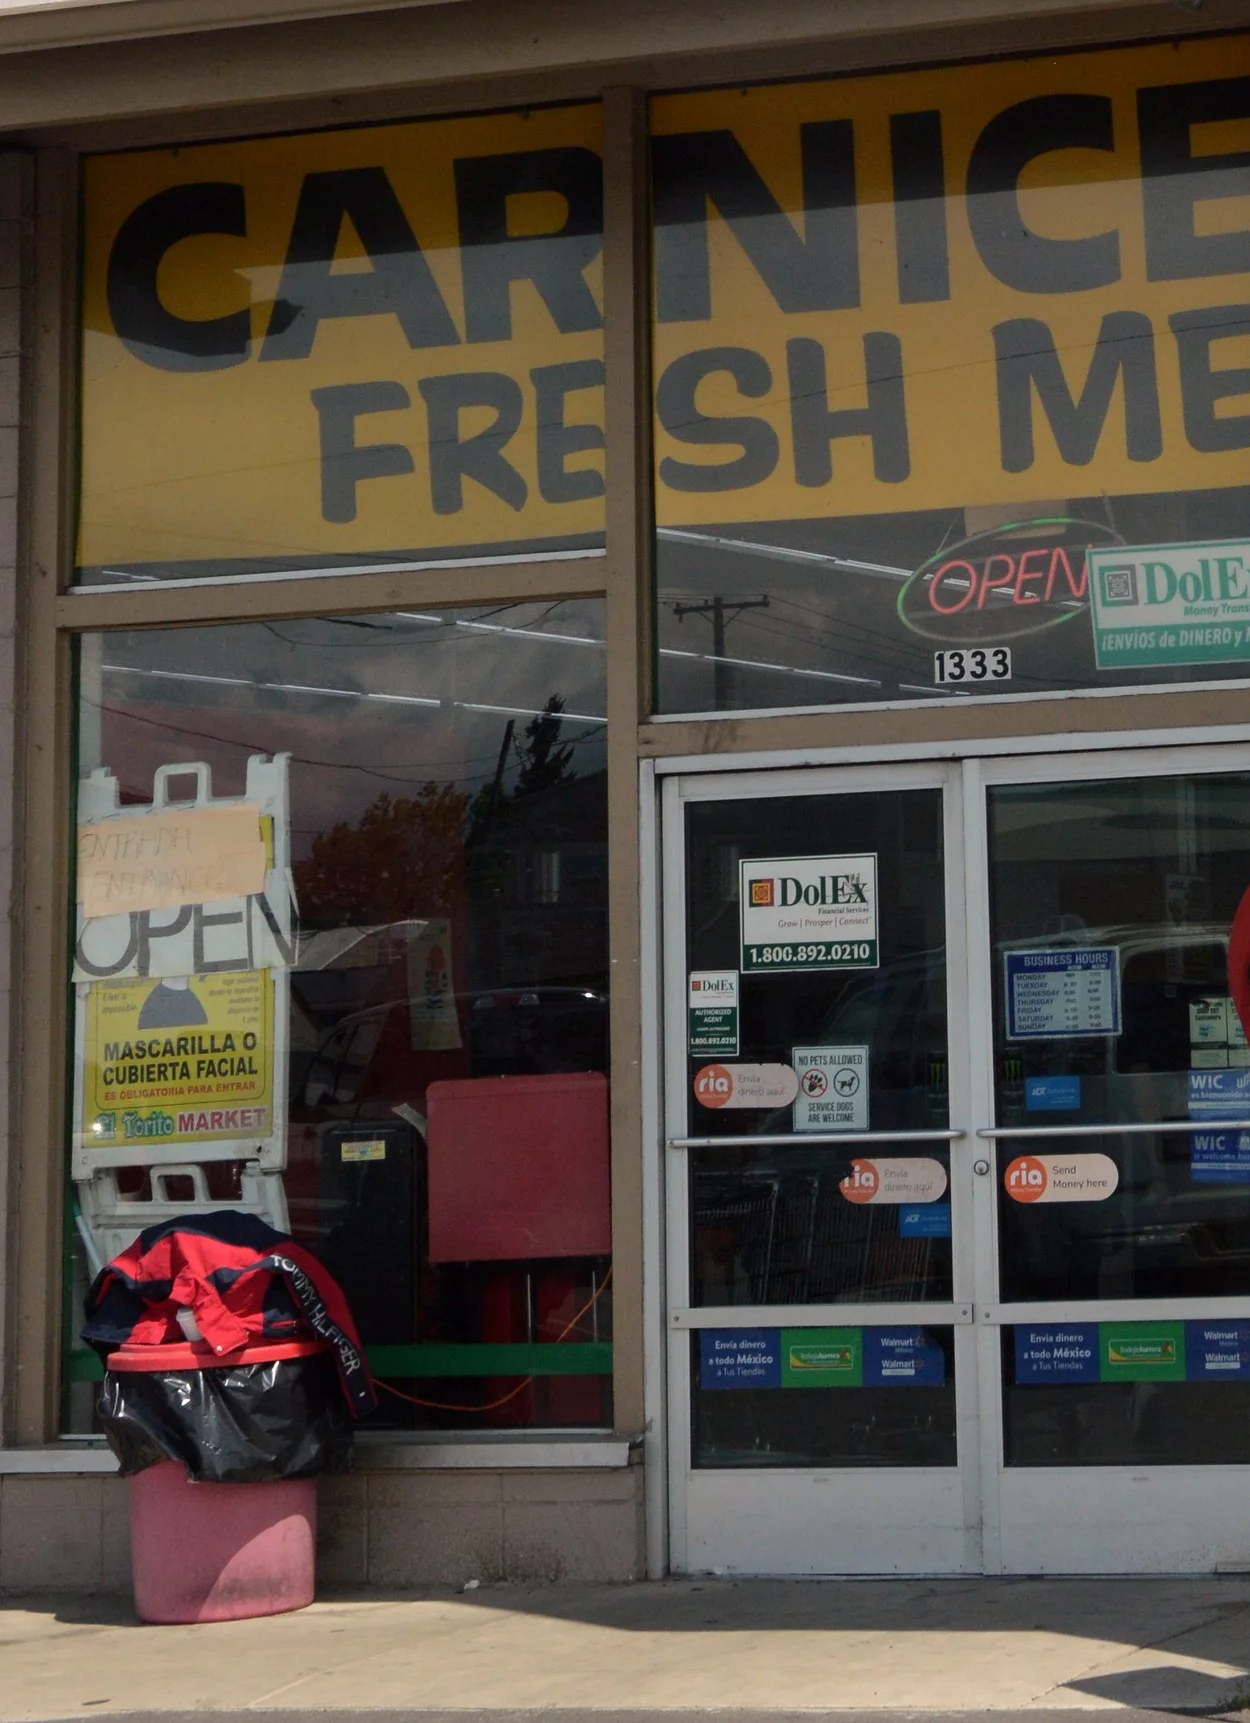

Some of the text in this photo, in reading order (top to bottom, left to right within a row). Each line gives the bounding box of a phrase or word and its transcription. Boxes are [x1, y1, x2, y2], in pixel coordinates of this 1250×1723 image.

[310, 331, 912, 525] FRESH
[929, 543, 1092, 614] OPEN
[1183, 604, 1219, 617] Money
[1158, 630, 1176, 648] de
[1179, 625, 1232, 646] DINERO
[1233, 630, 1242, 649] y
[936, 649, 1009, 681] 1333
[778, 875, 869, 907] DolEx
[805, 918, 833, 928] Prosper
[839, 916, 869, 926] Connect
[750, 943, 870, 963] 1.800.892.0210
[1024, 953, 1109, 966] BUSINESS HOURS
[702, 979, 735, 992] DolEx
[104, 1032, 257, 1061] MASCARILLA O
[798, 1055, 863, 1066] NO PETS ALLOWED
[103, 1056, 258, 1086] CUBIERTA FACIAL
[699, 1070, 729, 1092] ria
[1191, 1075, 1224, 1089] WIC
[105, 1081, 255, 1101] ES OBLIGATORIA PARA ENTRAR
[808, 1102, 854, 1112] SERVICE DOGS
[178, 1108, 266, 1132] MARKET
[808, 1113, 855, 1123] ARE WELCOME
[1194, 1135, 1226, 1150] WIC
[1010, 1162, 1042, 1186] ria
[1053, 1166, 1076, 1175] Send
[1053, 1180, 1084, 1190] Money
[1086, 1179, 1107, 1188] here
[270, 1253, 361, 1376] TOMMY HILFIGER
[881, 1337, 914, 1346] Walmart
[1055, 1333, 1084, 1342] dinero
[1204, 1331, 1239, 1340] Walmart
[739, 1340, 766, 1349] dinero
[715, 1356, 735, 1365] todo
[1030, 1349, 1051, 1359] todo
[1205, 1353, 1240, 1362] Walmart
[881, 1359, 915, 1368] Walmart
